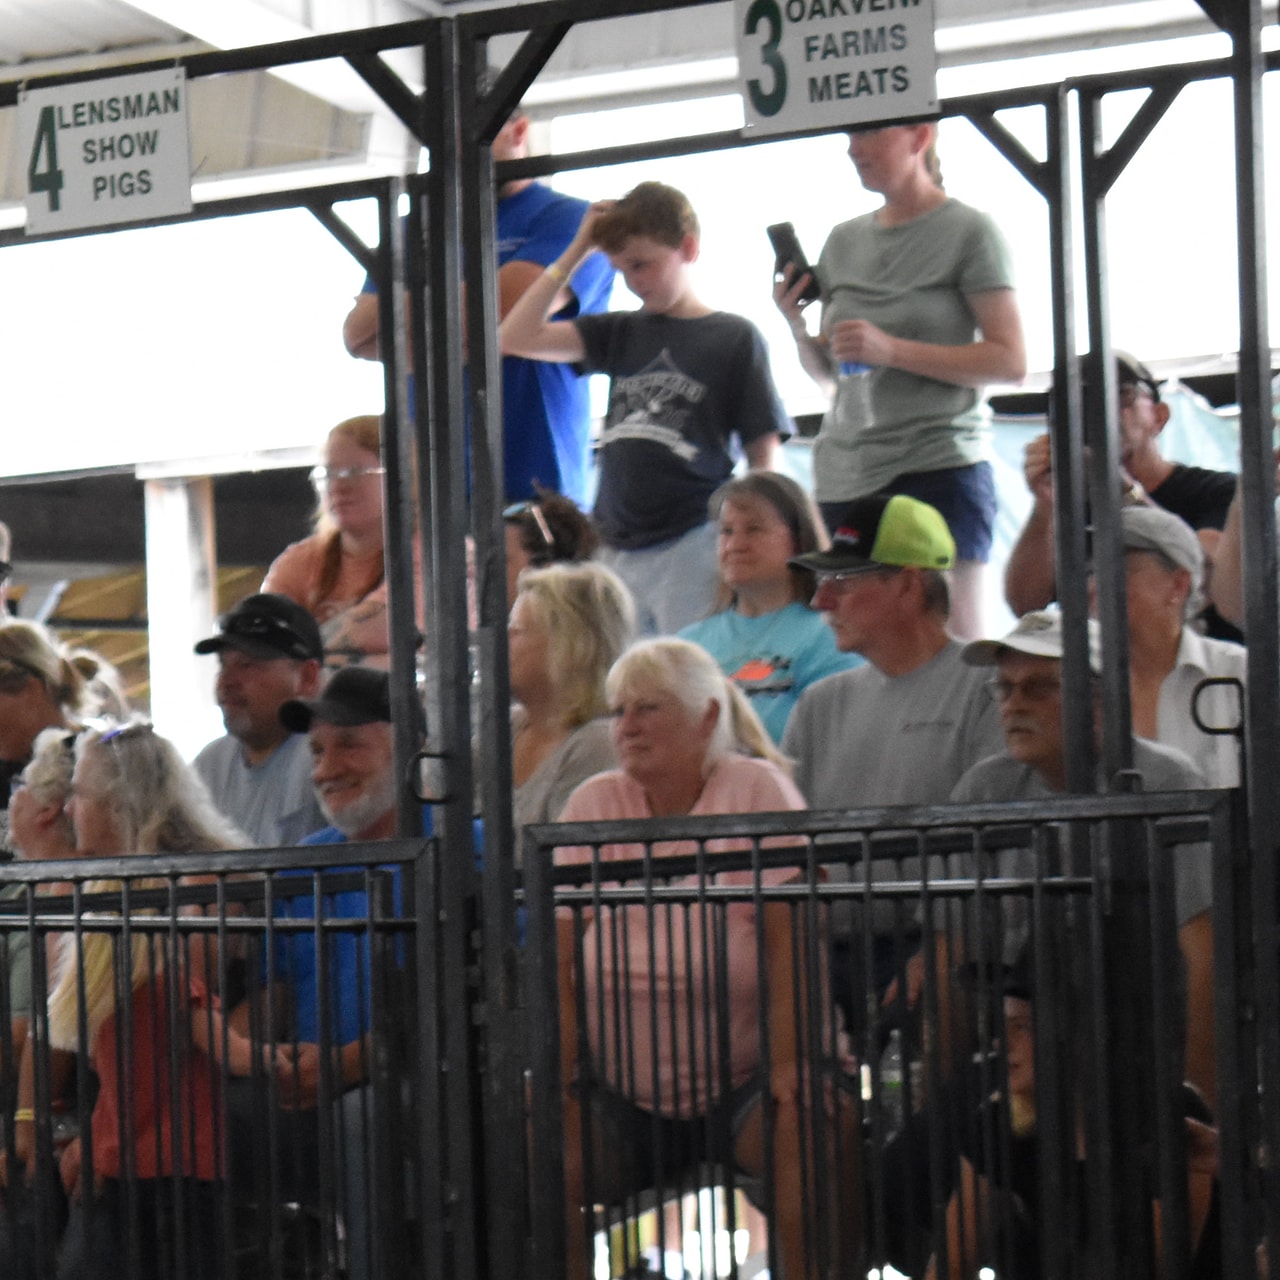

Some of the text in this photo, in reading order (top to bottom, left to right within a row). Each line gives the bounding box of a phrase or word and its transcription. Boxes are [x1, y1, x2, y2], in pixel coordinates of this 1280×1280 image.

[744, 0, 787, 117] 3
[804, 24, 909, 62] FARMS
[808, 65, 910, 103] MEATS
[57, 88, 180, 130] LENSMAN
[28, 105, 63, 212] 4
[82, 130, 158, 164] SHOW
[93, 170, 152, 201] PIGS
